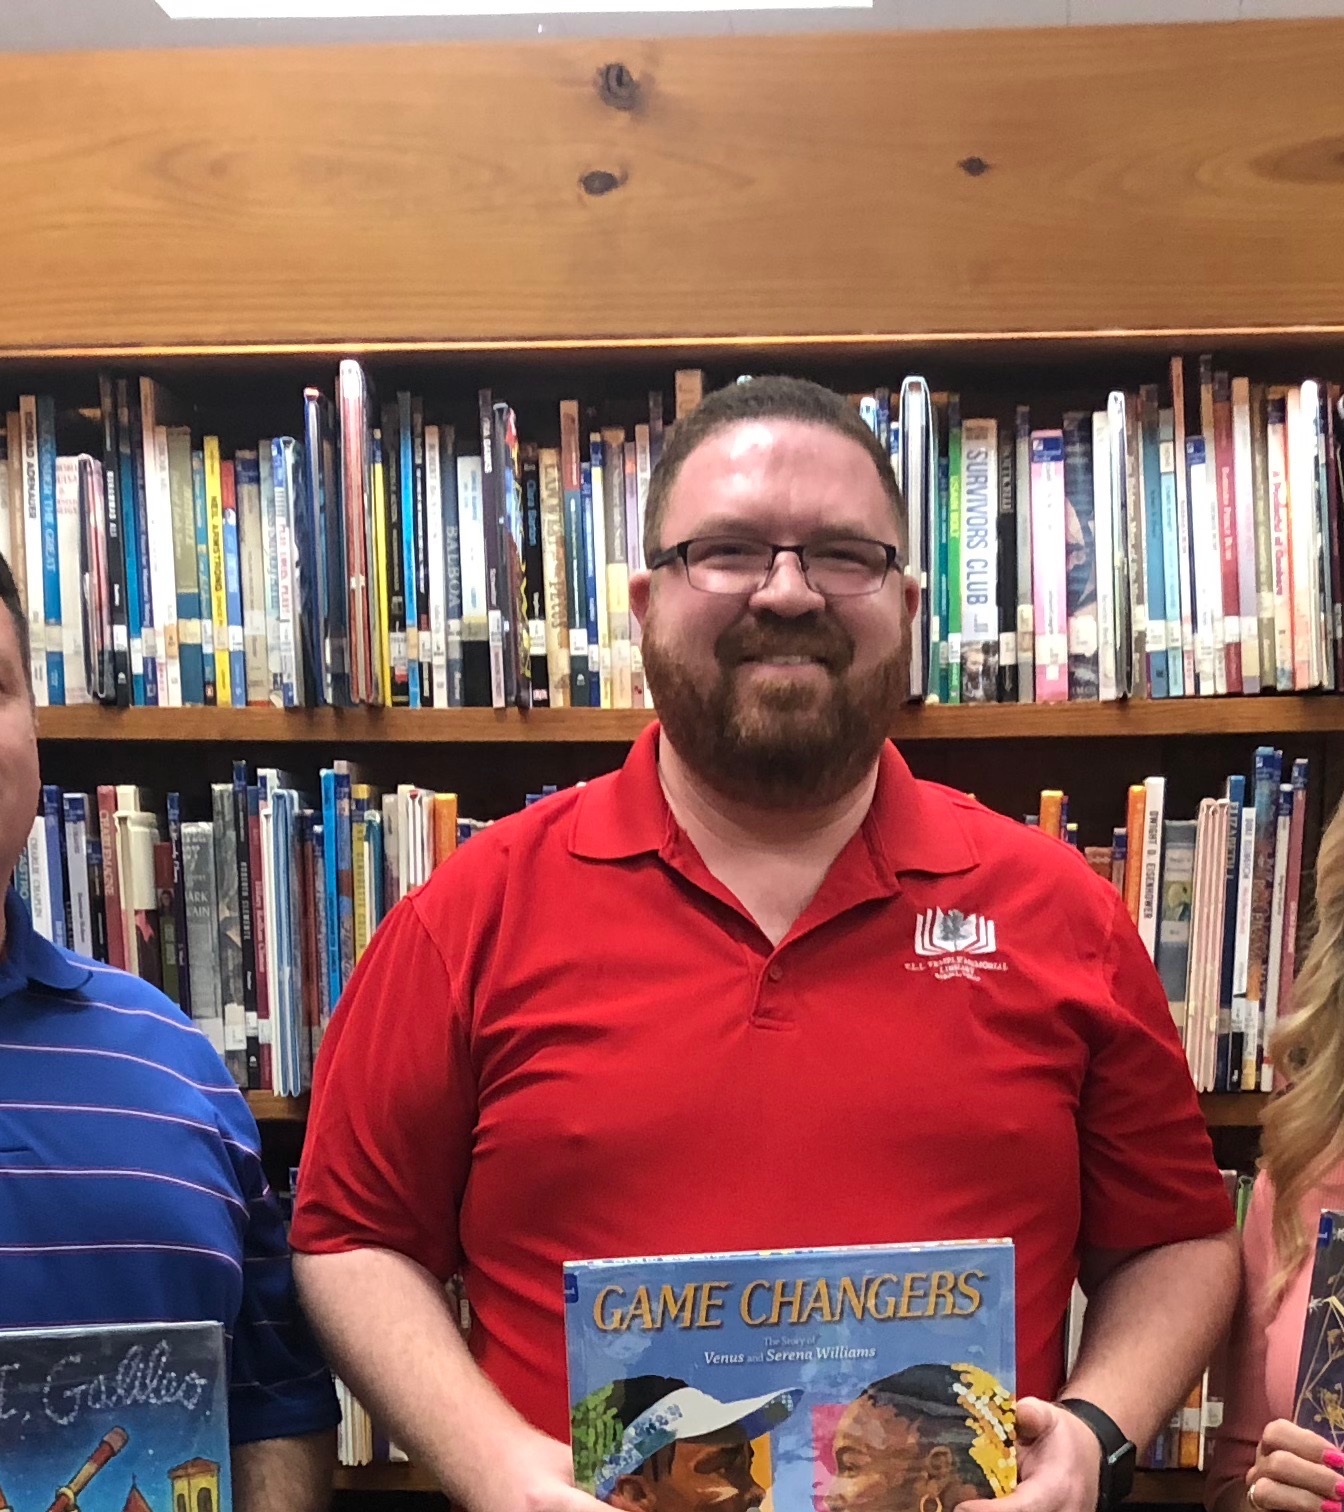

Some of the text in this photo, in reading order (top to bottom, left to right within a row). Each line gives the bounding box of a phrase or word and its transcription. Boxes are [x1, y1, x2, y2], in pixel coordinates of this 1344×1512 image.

[25, 412, 36, 519] KONRAD ADENAUER
[210, 496, 223, 592] NEIL ARMSTRONG
[527, 480, 537, 546] Clara Barton
[966, 449, 988, 605] SURVIVORS CLUB
[45, 529, 56, 572] GREAT
[446, 526, 460, 608] BALBOA
[99, 810, 114, 896] CHARLEMAGNE
[1148, 811, 1159, 845] DWIGHT
[1144, 863, 1156, 919] EISENHOWER
[593, 1270, 986, 1331] GAME CHANGERS
[704, 1345, 876, 1364] Venus and Serena Williams
[764, 1336, 816, 1347] The Story of
